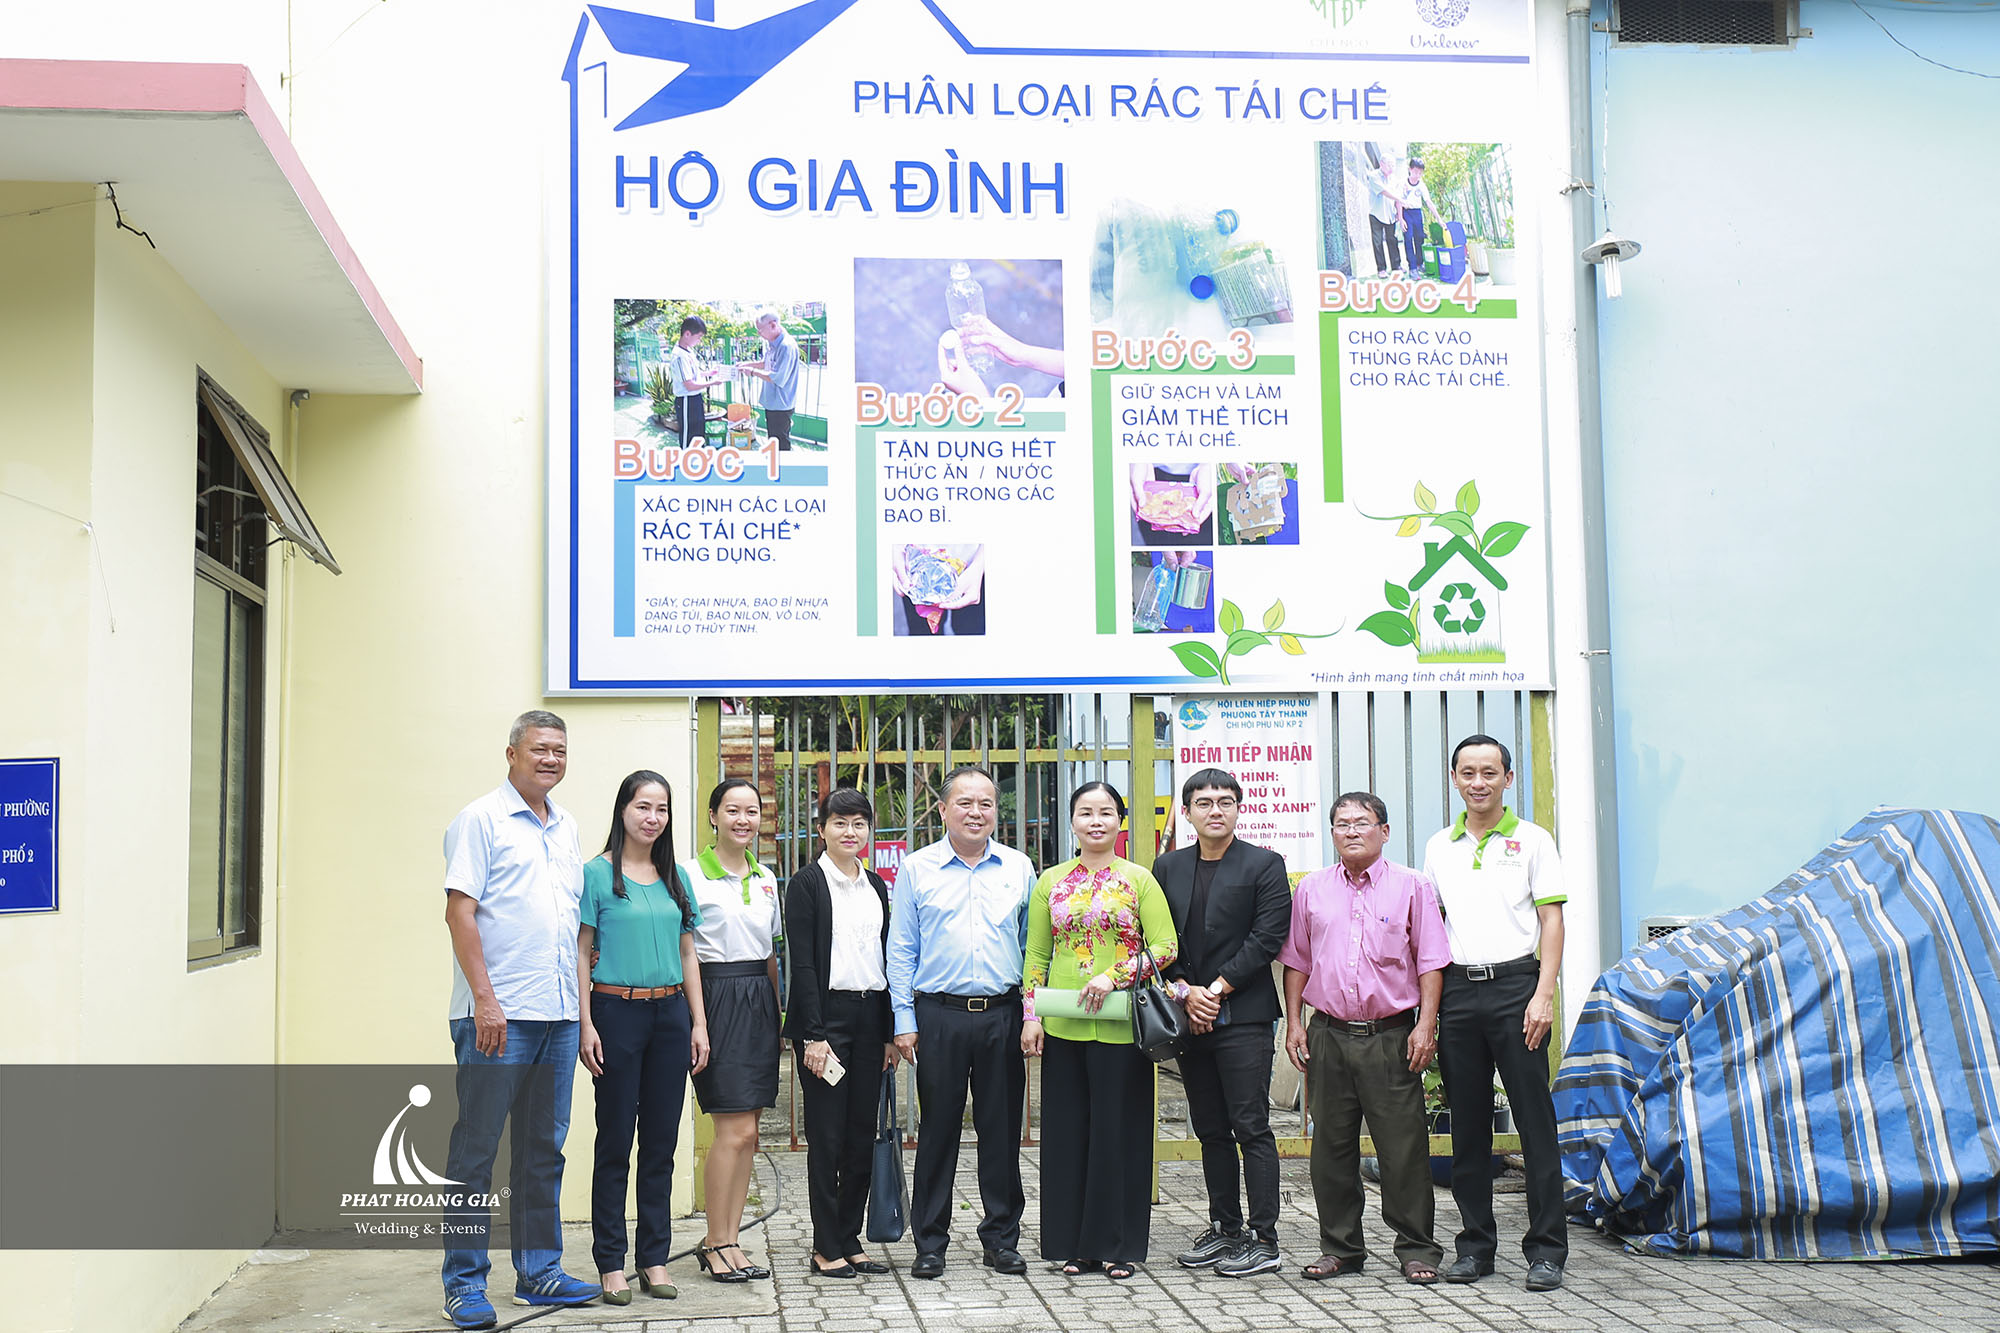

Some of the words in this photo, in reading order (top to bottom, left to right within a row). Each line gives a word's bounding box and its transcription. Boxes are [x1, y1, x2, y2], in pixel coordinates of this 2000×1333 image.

[1411, 34, 1479, 48] Unilever
[855, 75, 973, 114] PHÂN
[994, 84, 1090, 122] LOẠI
[1112, 78, 1200, 118] RÁC
[1216, 80, 1280, 118] TÁI
[1300, 82, 1388, 120] CHẾ
[616, 151, 718, 220] HỘ
[749, 158, 872, 211] GIA
[890, 149, 1063, 213] ĐÌNH
[1320, 274, 1436, 309] Bước
[1454, 275, 1476, 308] 4
[1349, 331, 1386, 344] CHO
[1393, 328, 1429, 344] RÁC
[1435, 328, 1471, 344] VÀO
[1093, 331, 1211, 366] Bước
[1231, 331, 1252, 366] 3
[1349, 349, 1410, 365] THÙNG
[1418, 349, 1453, 365] RÁC
[1460, 349, 1507, 365] DÀNH
[1350, 373, 1388, 386] CHO
[1395, 370, 1430, 386] RÁC
[1436, 370, 1462, 386] TÁI
[1470, 370, 1509, 386] CHẾ.
[1121, 383, 1155, 399] GIỮ
[1162, 386, 1209, 402] SẠCH
[1216, 383, 1240, 399] VÀ
[1246, 383, 1281, 399] LÀM
[858, 386, 979, 422] Bước
[999, 387, 1021, 422] 2
[1122, 405, 1178, 426] GIẢM
[1186, 405, 1229, 425] THỂ
[1237, 405, 1288, 425] TÍCH
[1123, 431, 1159, 447] RÁC
[1165, 430, 1192, 447] TÁI
[1200, 430, 1240, 447] CHẾ.
[615, 440, 739, 476] Bước
[762, 441, 775, 476] 1
[883, 439, 928, 461] TẬN
[938, 441, 1003, 461] DỤNG
[1012, 437, 1056, 458] HẾT
[884, 463, 936, 479] THỨC
[944, 463, 967, 479] ĂN
[980, 466, 984, 479] /
[997, 463, 1052, 479] NƯỚC
[945, 487, 1010, 501] TRONG
[1017, 484, 1054, 501] CÁC
[642, 495, 680, 512] XÁC
[687, 498, 732, 515] ĐỊNH
[739, 496, 777, 512] CÁC
[785, 499, 825, 516] LOẠI
[885, 509, 923, 522] BAO
[930, 506, 951, 522] BÌ.
[643, 518, 691, 540] RÁC
[699, 518, 734, 540] TÁI
[642, 544, 709, 561] THÔNG
[717, 547, 775, 564] DỤNG.
[683, 598, 710, 607] CHAI
[713, 598, 749, 608] NHỰA,
[754, 598, 777, 607] BAO
[781, 597, 792, 607] BÌ
[796, 598, 828, 608] NHỰA
[645, 611, 677, 621] DẠNG
[707, 611, 730, 620] BAO
[734, 611, 771, 620] NILON,
[796, 611, 820, 620] LON,
[645, 624, 672, 633] CHAI
[676, 624, 691, 634] LỌ
[730, 624, 757, 632] TINH.
[1348, 672, 1370, 682] ảnh
[1375, 674, 1408, 684] mang
[1440, 670, 1465, 681] chất
[1469, 671, 1498, 680] minh
[1503, 671, 1524, 682] họa
[1180, 739, 1221, 764] ĐIỂM
[1226, 740, 1262, 763] TIẾP
[1267, 742, 1312, 765] NHẬN
[1241, 769, 1279, 781] HÌNH:
[1248, 785, 1268, 797] NỮ
[1272, 784, 1286, 797] VÌ
[4, 798, 50, 817] PHƯỜNG
[2, 843, 26, 863] PHỐ
[28, 849, 34, 863] 2
